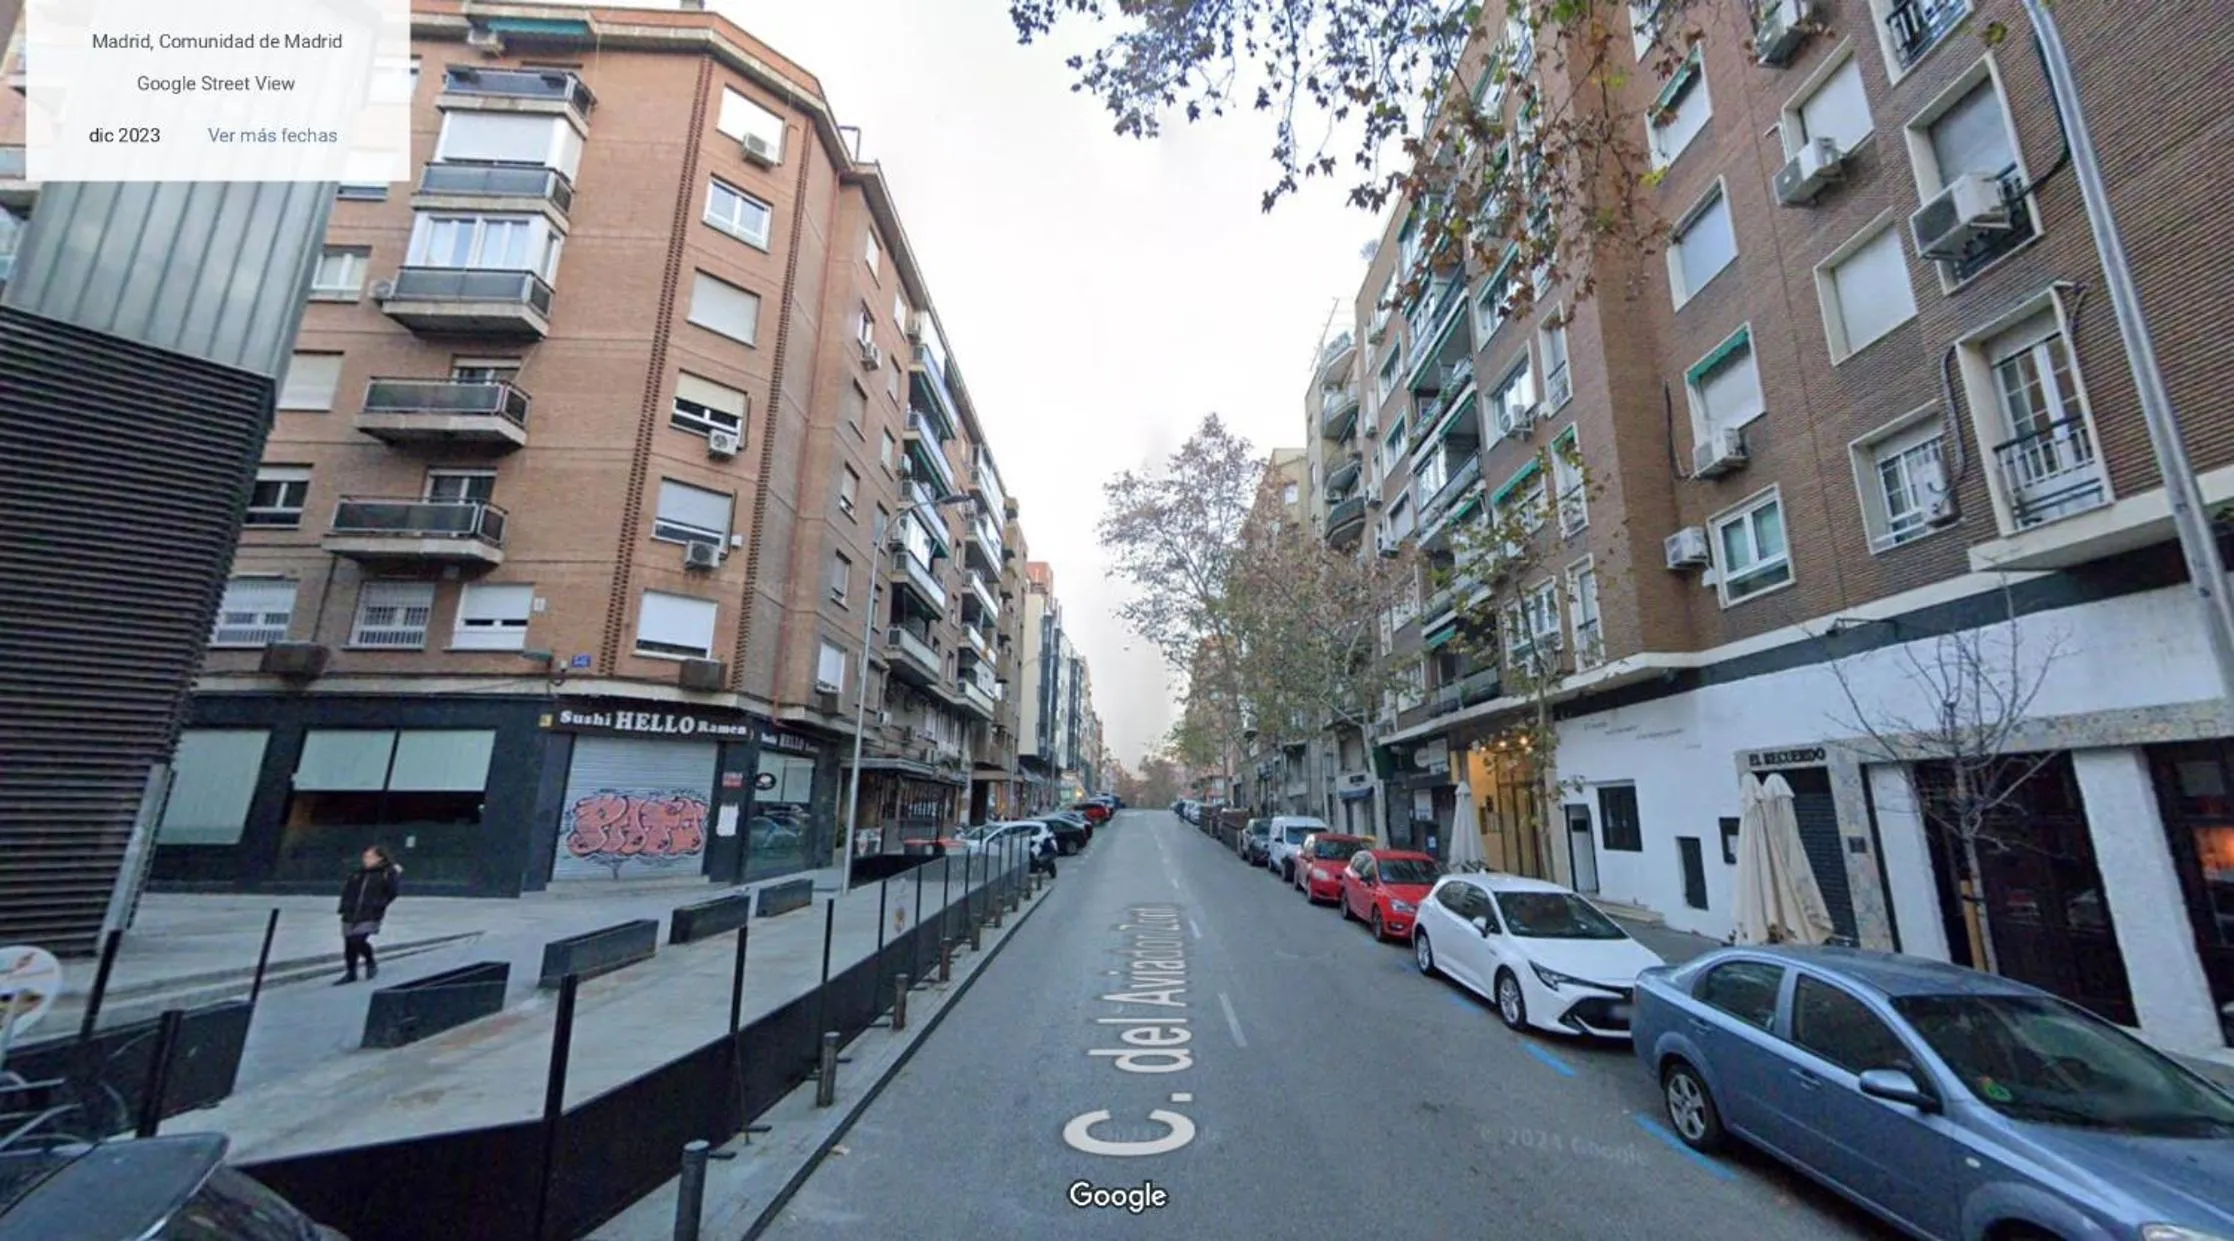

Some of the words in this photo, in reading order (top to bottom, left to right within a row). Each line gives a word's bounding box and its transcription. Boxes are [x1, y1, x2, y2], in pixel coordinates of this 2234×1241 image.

[560, 710, 612, 727] Sushi
[614, 711, 696, 734] HELLO
[697, 721, 748, 735] Ramen
